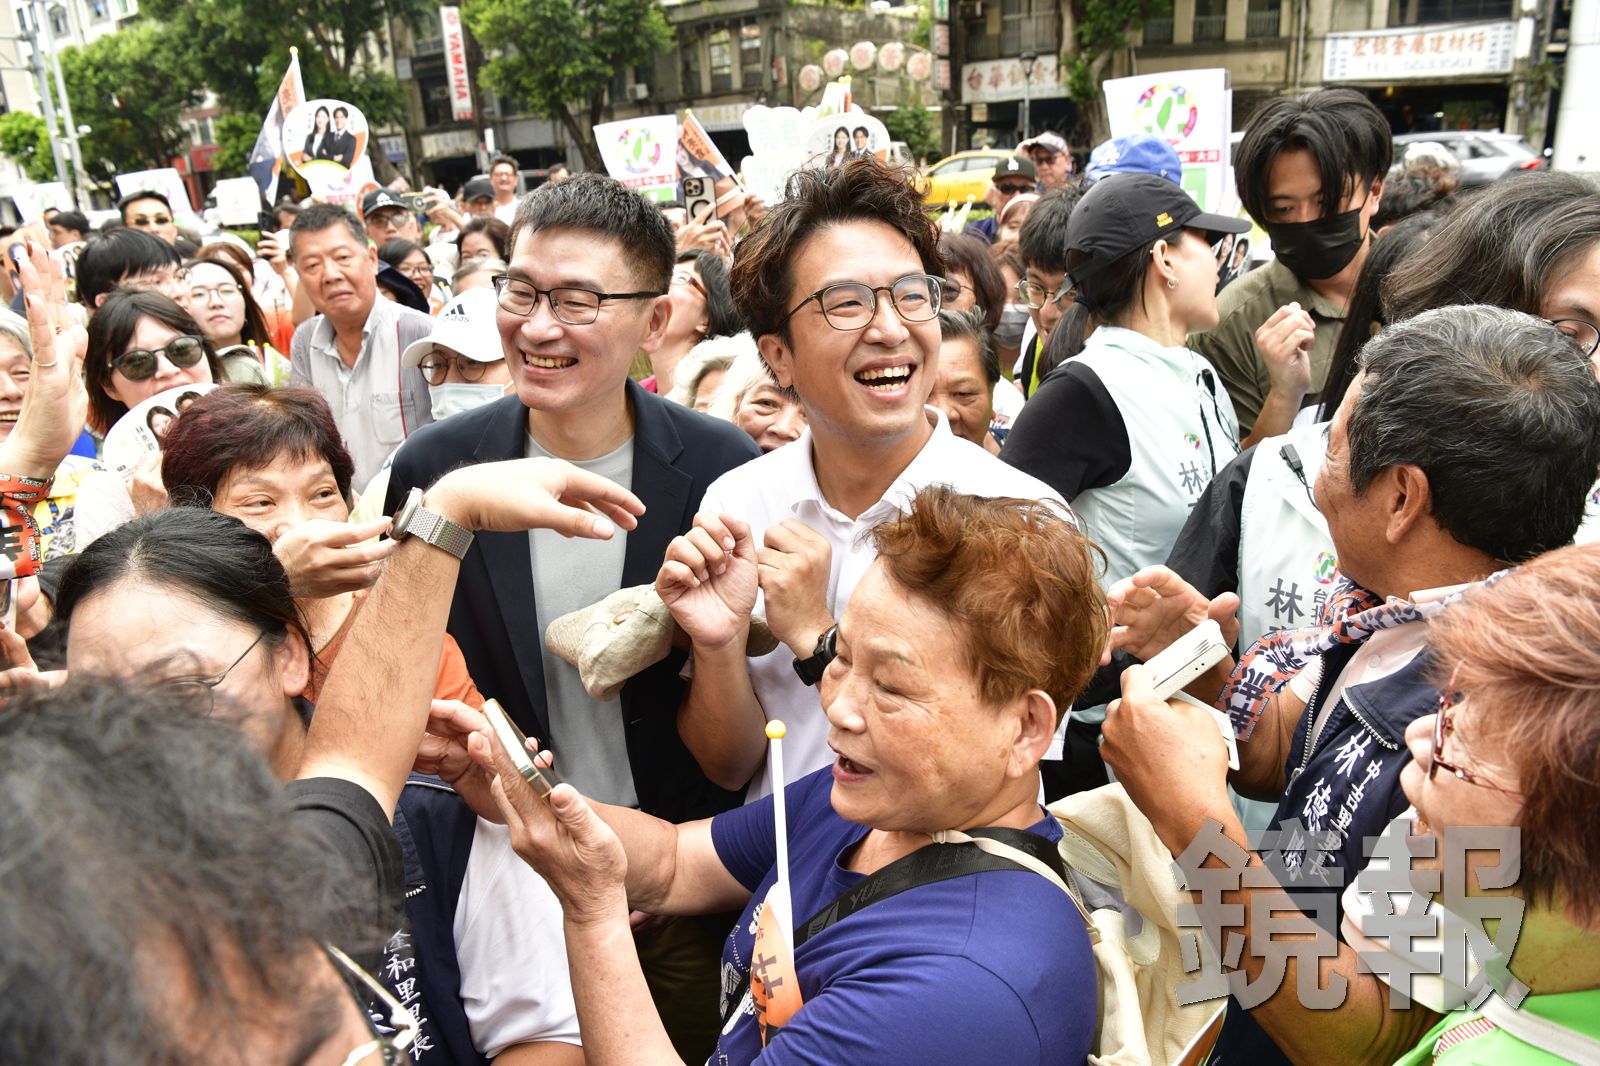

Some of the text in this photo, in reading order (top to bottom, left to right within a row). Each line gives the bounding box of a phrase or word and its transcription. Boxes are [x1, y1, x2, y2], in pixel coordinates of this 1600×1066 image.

[449, 32, 468, 99] YAMAHA
[1179, 461, 1204, 511] 林
[1265, 577, 1305, 630] 林
